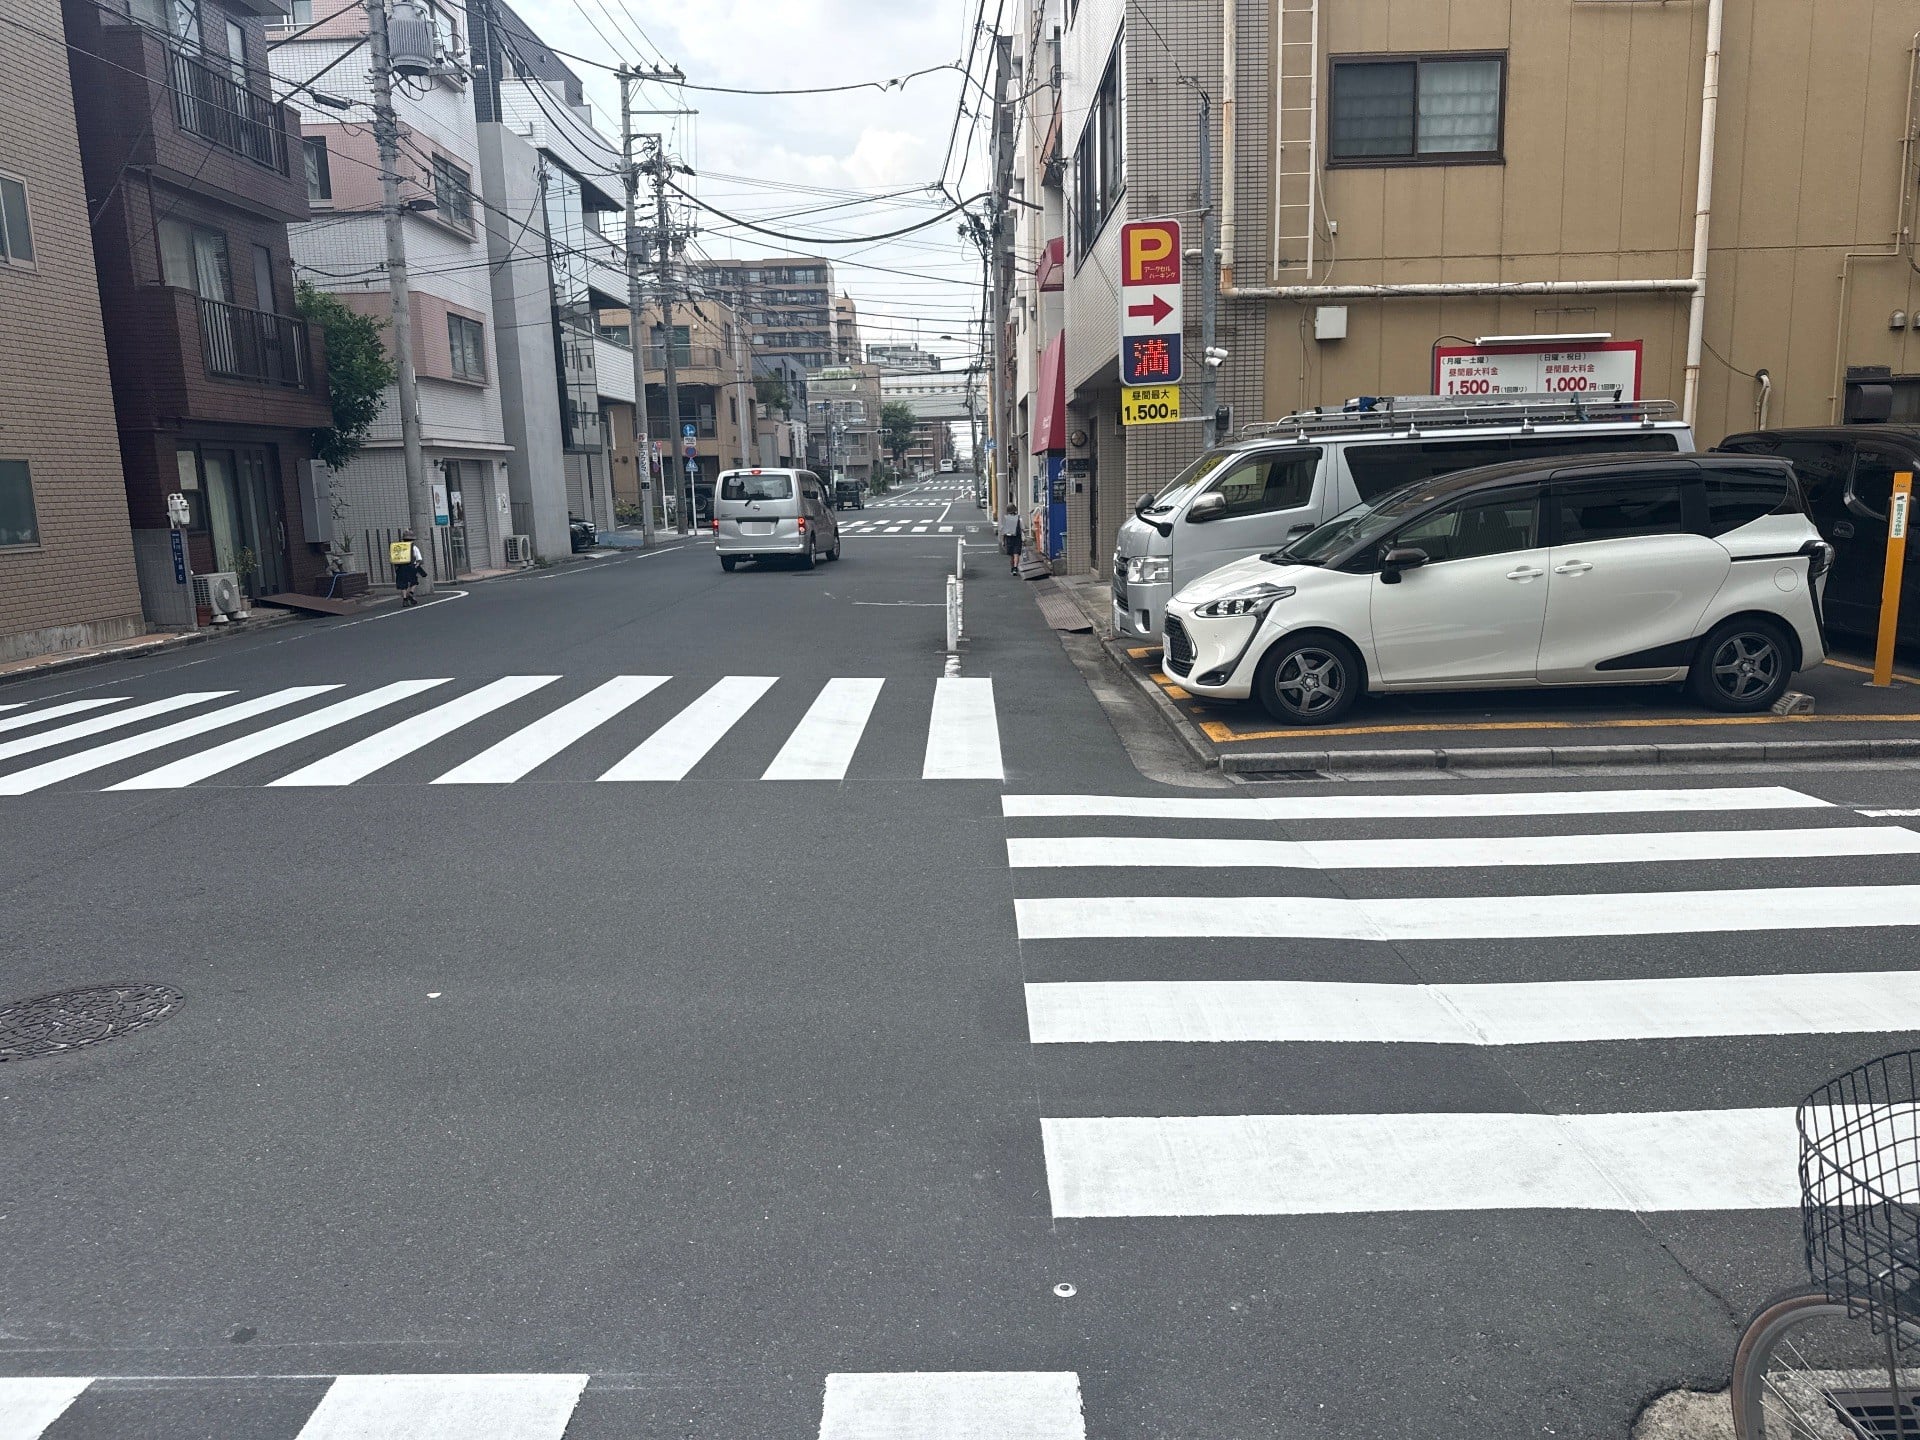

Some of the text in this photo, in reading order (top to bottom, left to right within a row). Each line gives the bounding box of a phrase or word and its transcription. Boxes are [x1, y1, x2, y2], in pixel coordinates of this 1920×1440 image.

[1129, 228, 1173, 281] P
[1133, 339, 1169, 376] 満
[1449, 366, 1498, 377] 昼間最大料金
[1545, 363, 1595, 374] 昼間最大料金
[1132, 388, 1170, 401] 昼間最大
